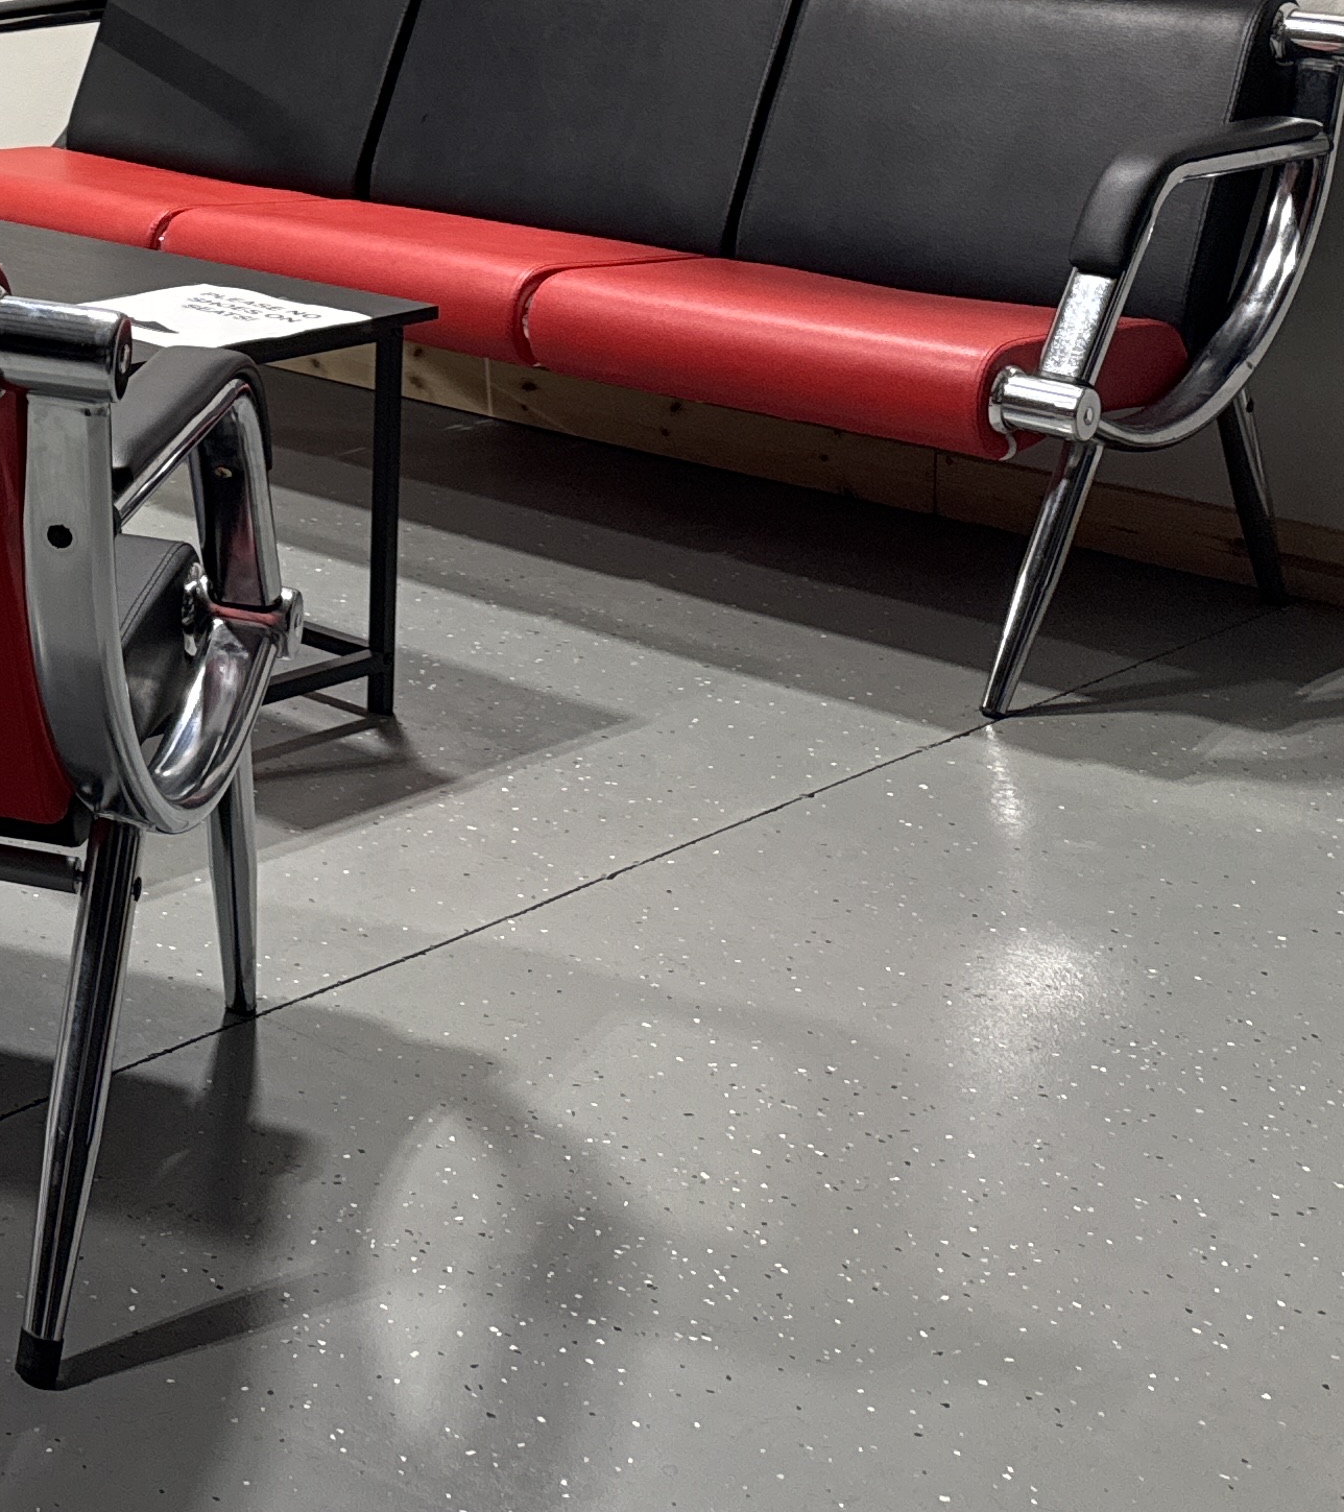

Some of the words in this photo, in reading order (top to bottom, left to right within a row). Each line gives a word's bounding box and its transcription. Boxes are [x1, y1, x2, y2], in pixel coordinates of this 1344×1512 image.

[187, 297, 263, 315] SHOES
[264, 313, 302, 323] ON
[200, 292, 286, 311] PLEASE
[286, 310, 322, 319] NO
